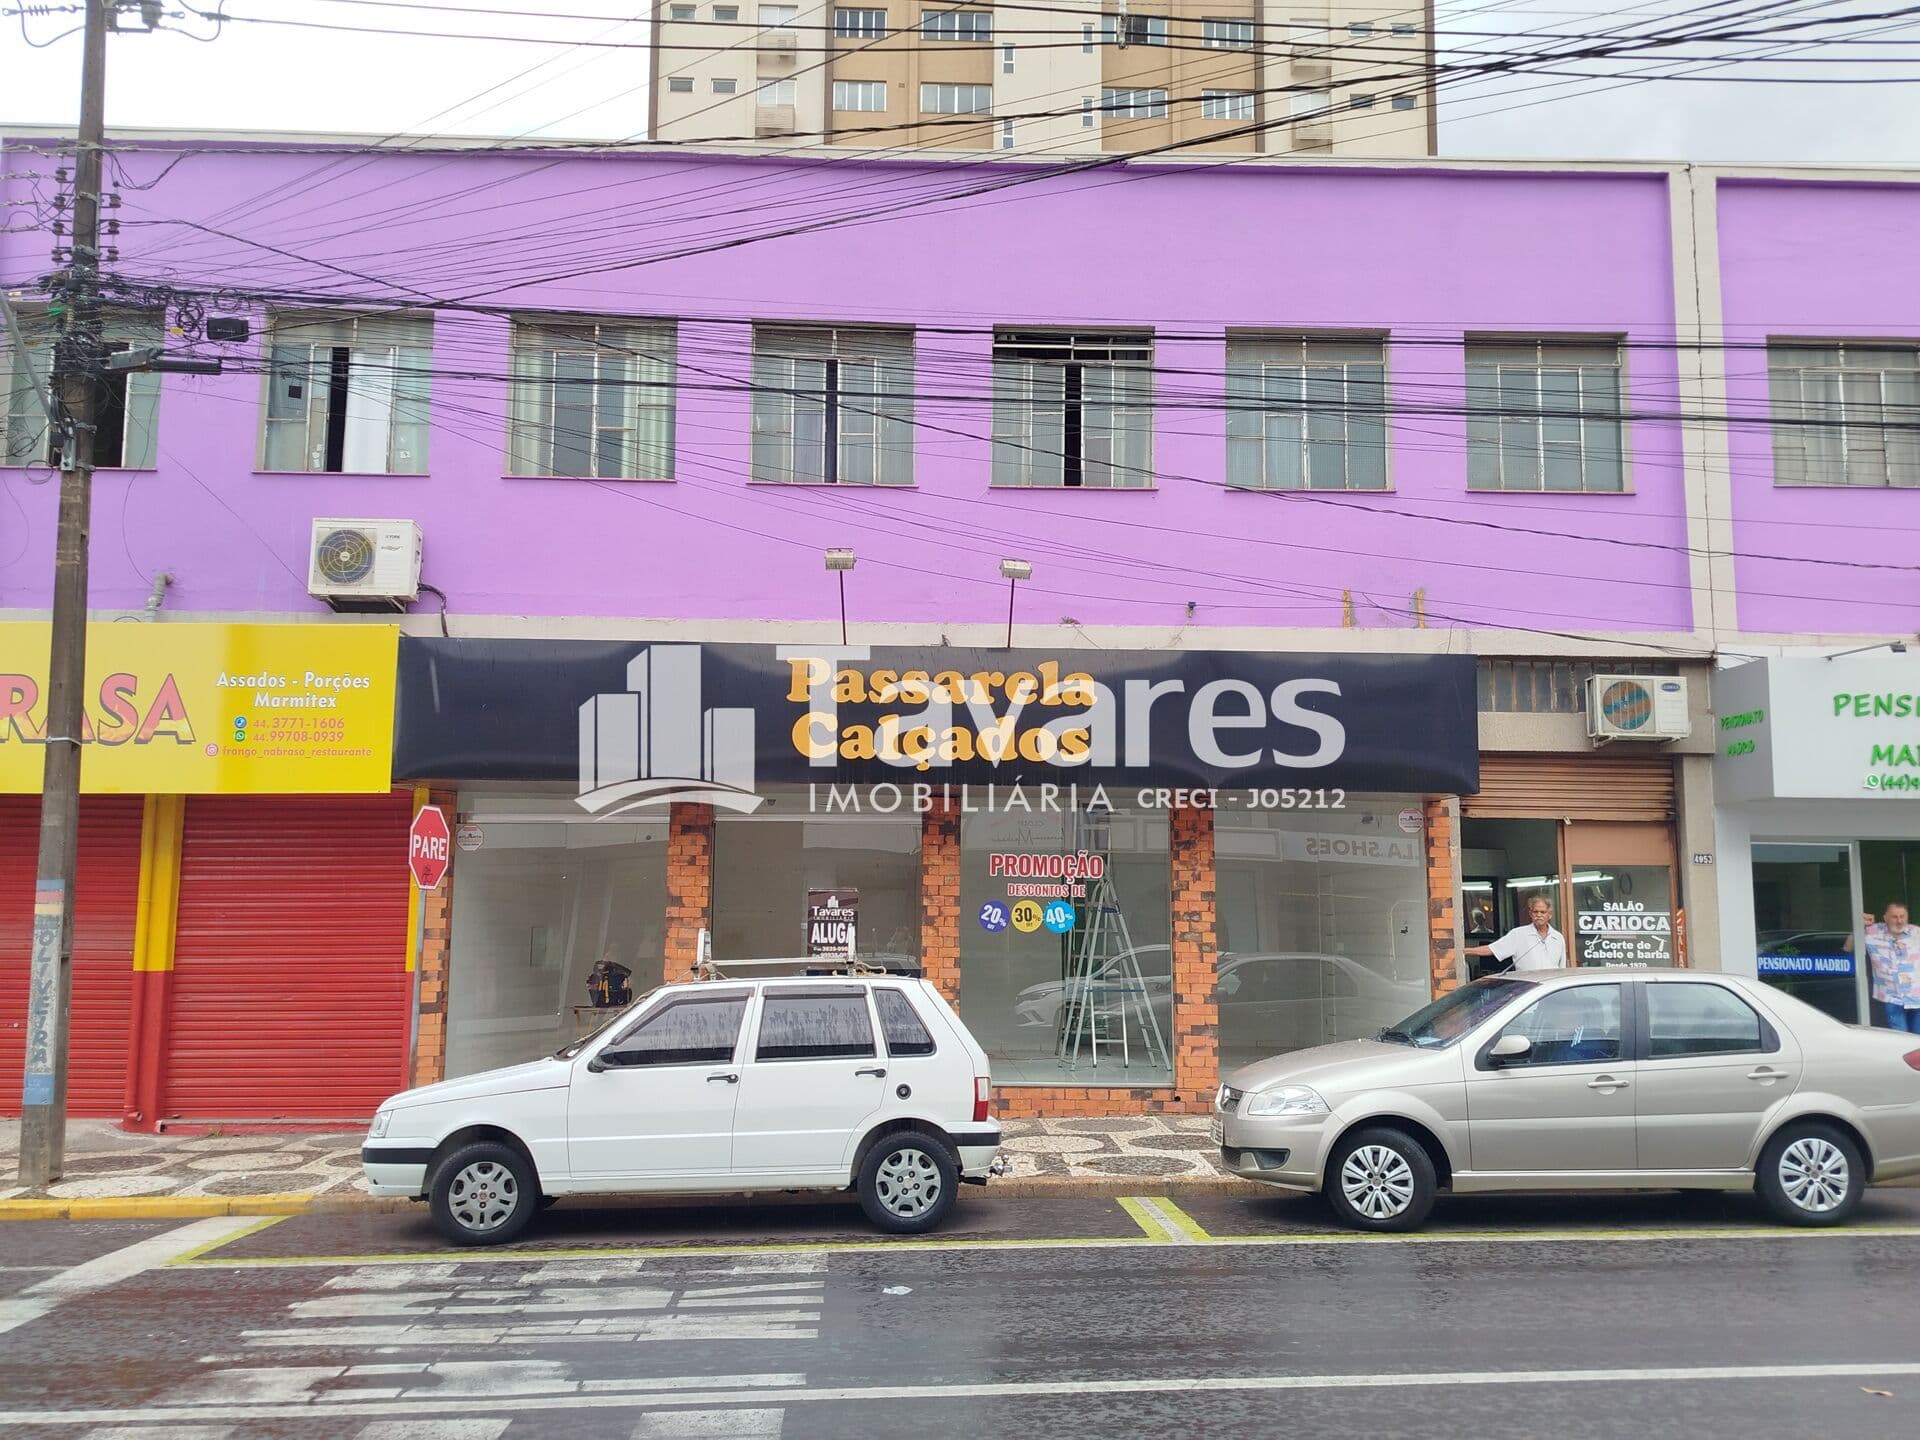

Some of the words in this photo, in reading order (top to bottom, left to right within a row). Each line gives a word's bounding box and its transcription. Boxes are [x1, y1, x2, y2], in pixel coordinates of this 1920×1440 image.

[216, 672, 286, 688] Assados
[304, 672, 370, 692] Porções
[786, 656, 1097, 704] Passarela
[254, 692, 337, 708] Marmitex
[0, 673, 196, 746] RSA
[253, 731, 344, 742] 44.99708-0939
[791, 711, 1090, 771] Calçados
[1870, 744, 1920, 766] MA
[412, 834, 447, 861] PARE
[990, 850, 1103, 884] PROMOÇÃO
[1007, 883, 1069, 897] DESCONTOS
[1072, 884, 1086, 898] DE
[811, 906, 855, 917] Tavares
[1603, 901, 1644, 912] SALÃO
[1579, 915, 1670, 931] CARIOCA
[1601, 940, 1634, 950] Corte
[1636, 940, 1651, 950] de
[1584, 949, 1624, 959] Cabelo
[1626, 951, 1634, 959] e
[1637, 949, 1670, 959] barba
[1758, 957, 1812, 971] PENSIONATO
[1814, 958, 1850, 972] MADRID
[31, 929, 55, 1064] OLIVEIRA
